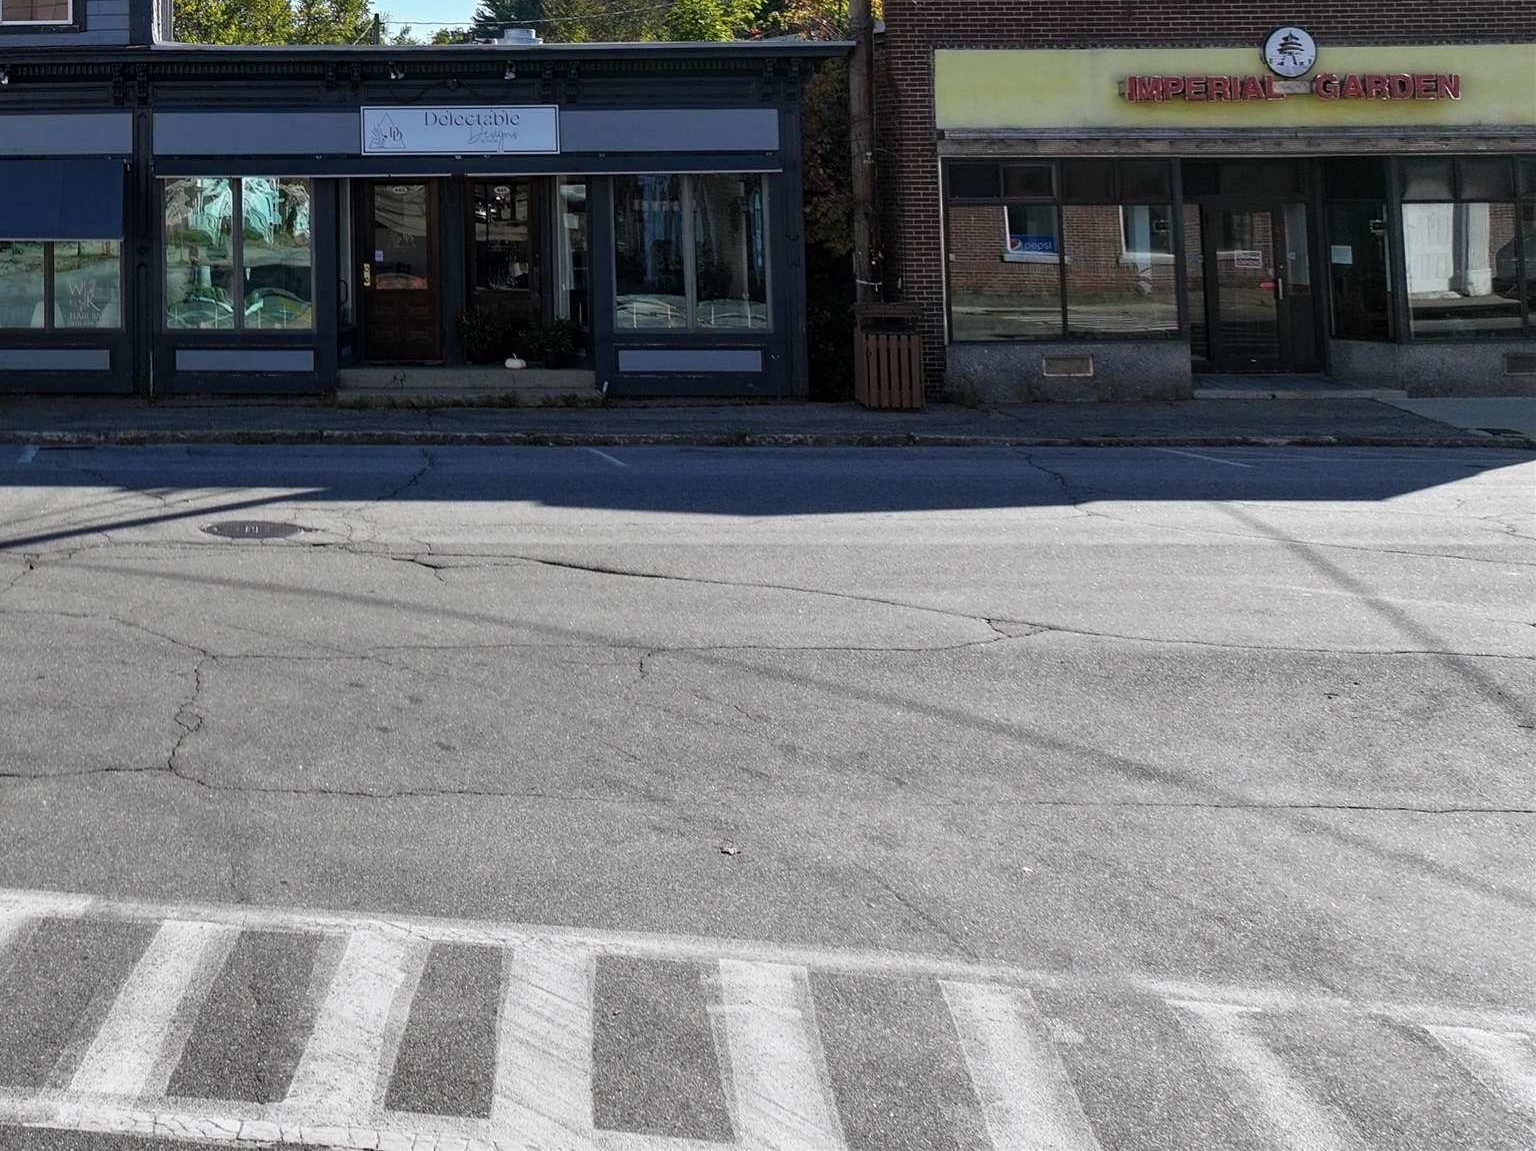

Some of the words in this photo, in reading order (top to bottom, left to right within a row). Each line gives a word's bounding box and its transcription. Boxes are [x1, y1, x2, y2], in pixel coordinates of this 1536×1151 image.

[1126, 75, 1287, 101] IMPERIAL
[1312, 73, 1463, 100] GARDEN
[424, 110, 521, 127] Delectable
[1024, 241, 1051, 251] pepsi
